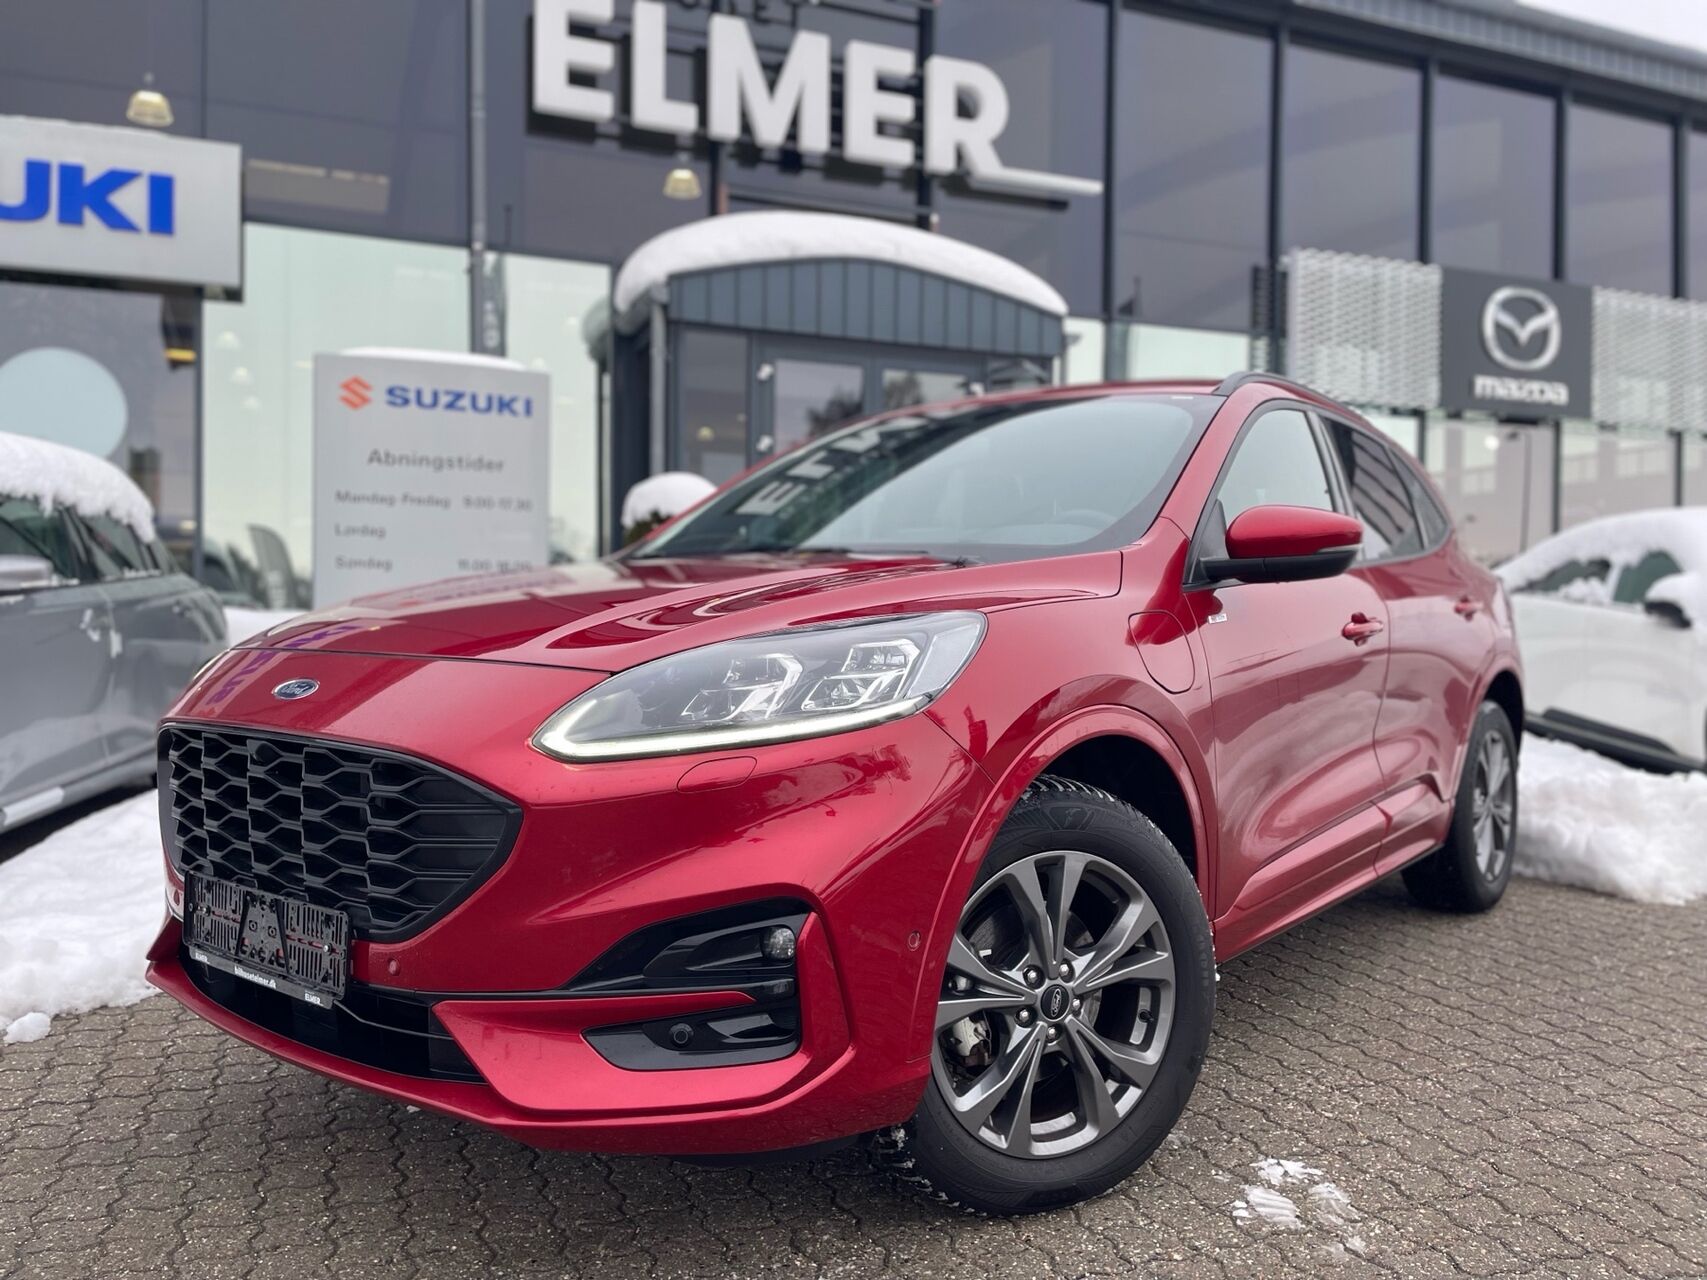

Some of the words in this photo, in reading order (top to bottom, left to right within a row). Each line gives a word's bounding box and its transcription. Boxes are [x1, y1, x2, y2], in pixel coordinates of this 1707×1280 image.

[533, 0, 1103, 194] ELMER
[385, 384, 533, 417] SUZUKI
[1474, 373, 1569, 406] mazda
